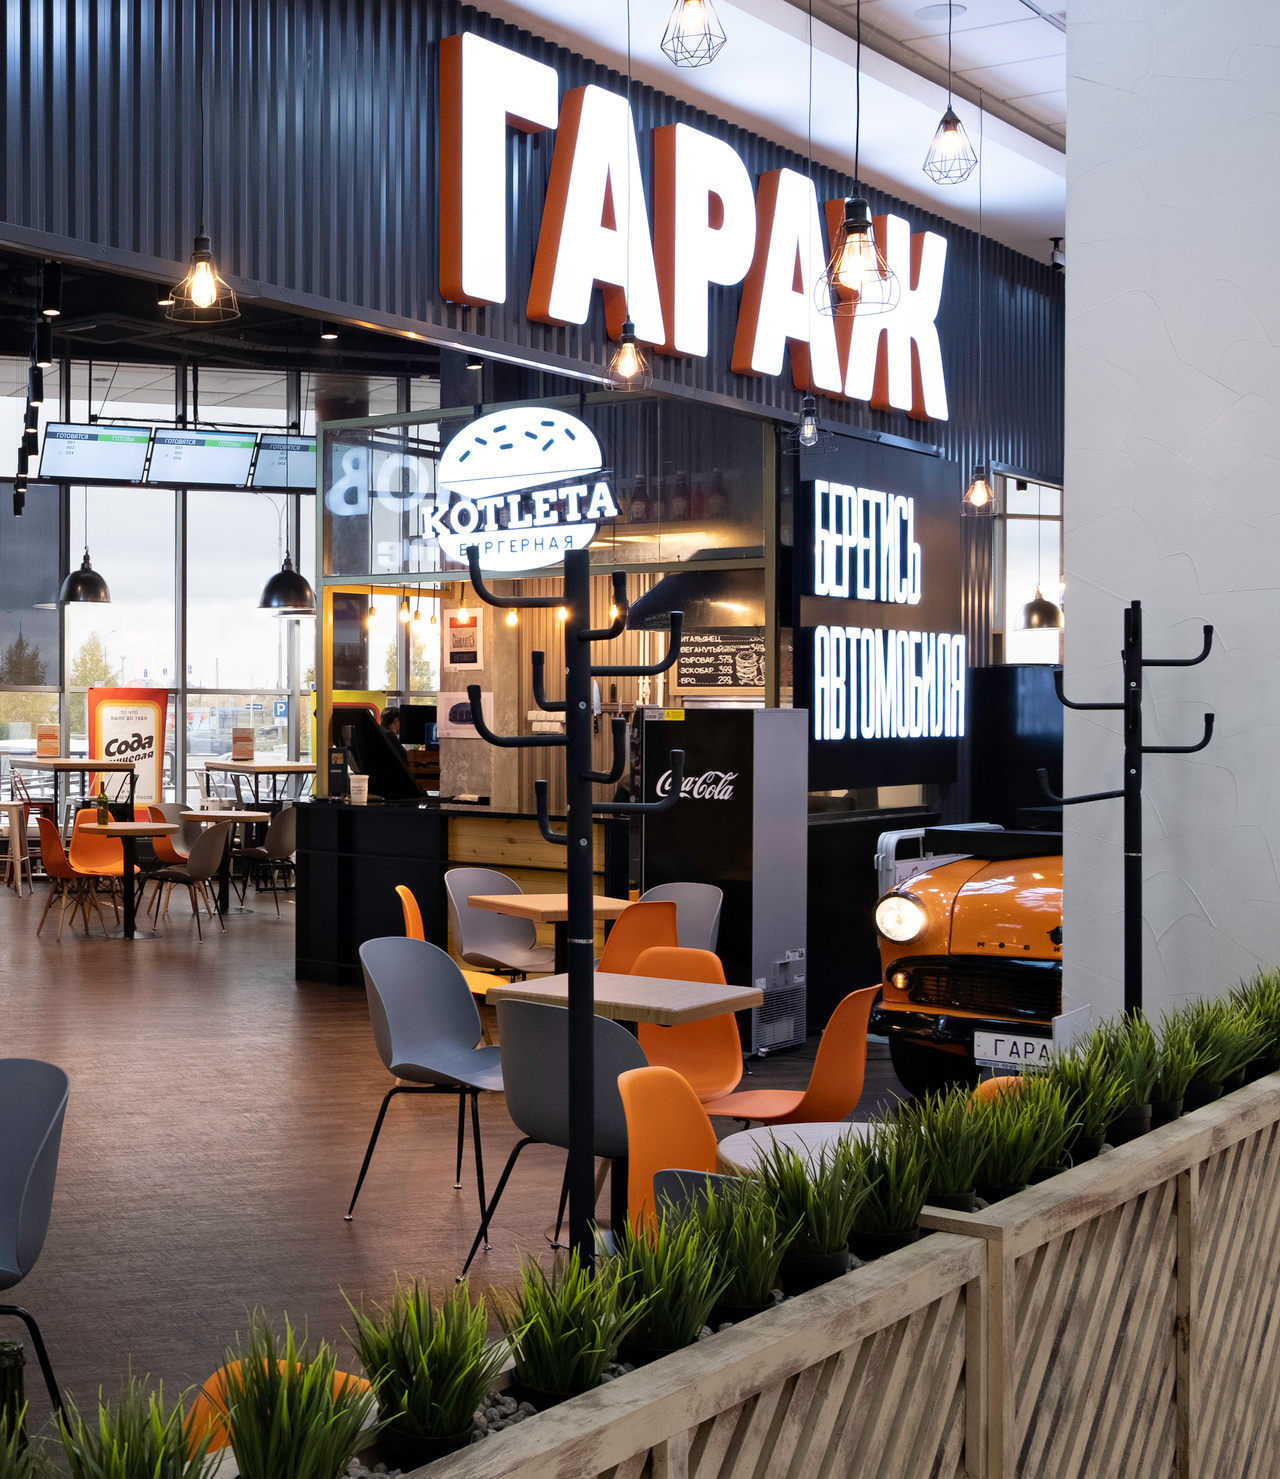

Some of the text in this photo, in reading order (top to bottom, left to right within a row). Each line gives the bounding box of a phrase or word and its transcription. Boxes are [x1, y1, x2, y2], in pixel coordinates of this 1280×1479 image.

[448, 31, 949, 422] ГАРАЖ
[421, 482, 619, 540] KOTLETA
[459, 535, 574, 556] БРГЕРНАЯ
[814, 479, 922, 605] БЕРЕГИСЬ
[680, 644, 723, 654] ВЕГАНУТЫЙ
[680, 656, 715, 664] СЫРОВАР
[680, 666, 714, 674] ЭСКОБАР
[814, 625, 966, 740] АВТОМОБИЛЯ
[276, 703, 286, 716] P
[105, 733, 154, 757] Сода
